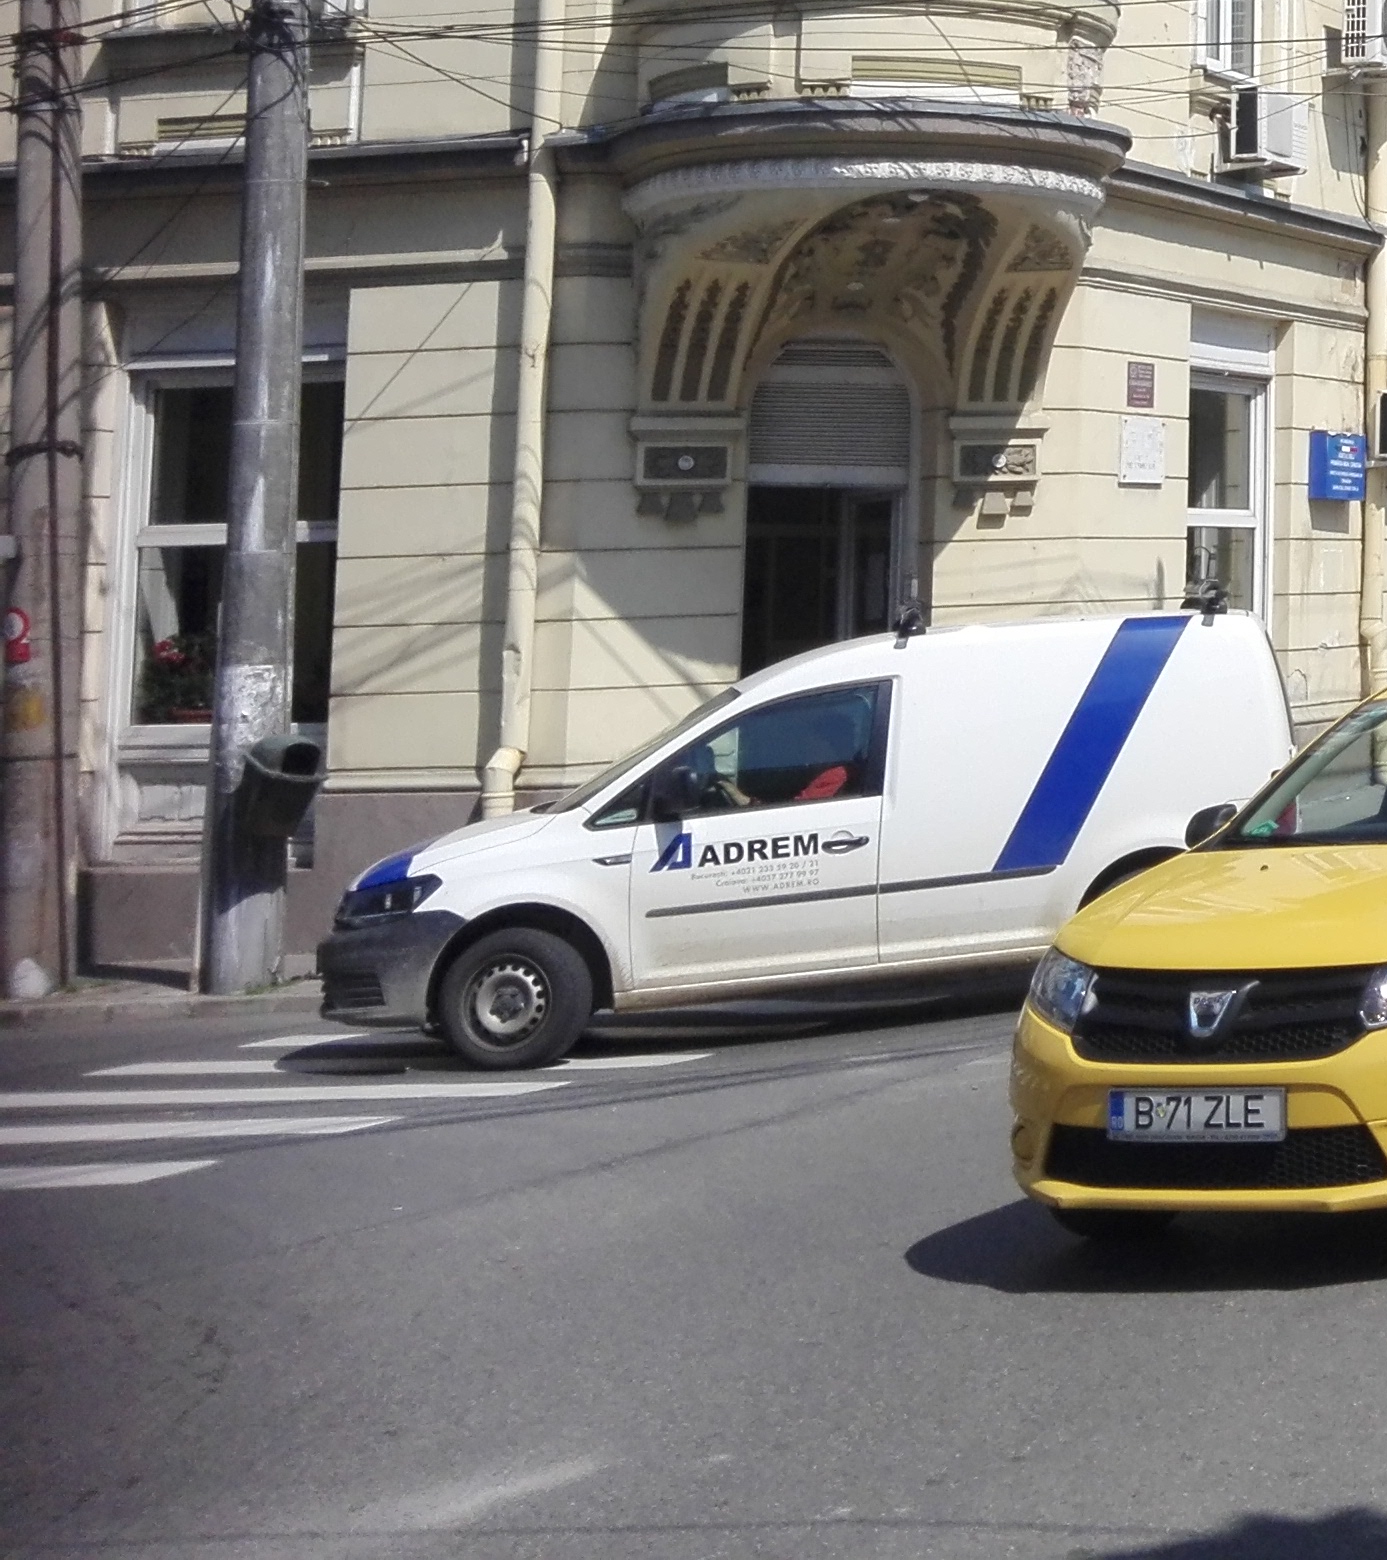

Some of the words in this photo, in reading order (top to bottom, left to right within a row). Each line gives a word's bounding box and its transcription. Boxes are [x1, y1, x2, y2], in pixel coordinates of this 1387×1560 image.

[698, 833, 819, 868] ADREM
[1135, 1095, 1154, 1129] B
[1165, 1095, 1192, 1130] 71
[1203, 1094, 1265, 1128] ZLE
